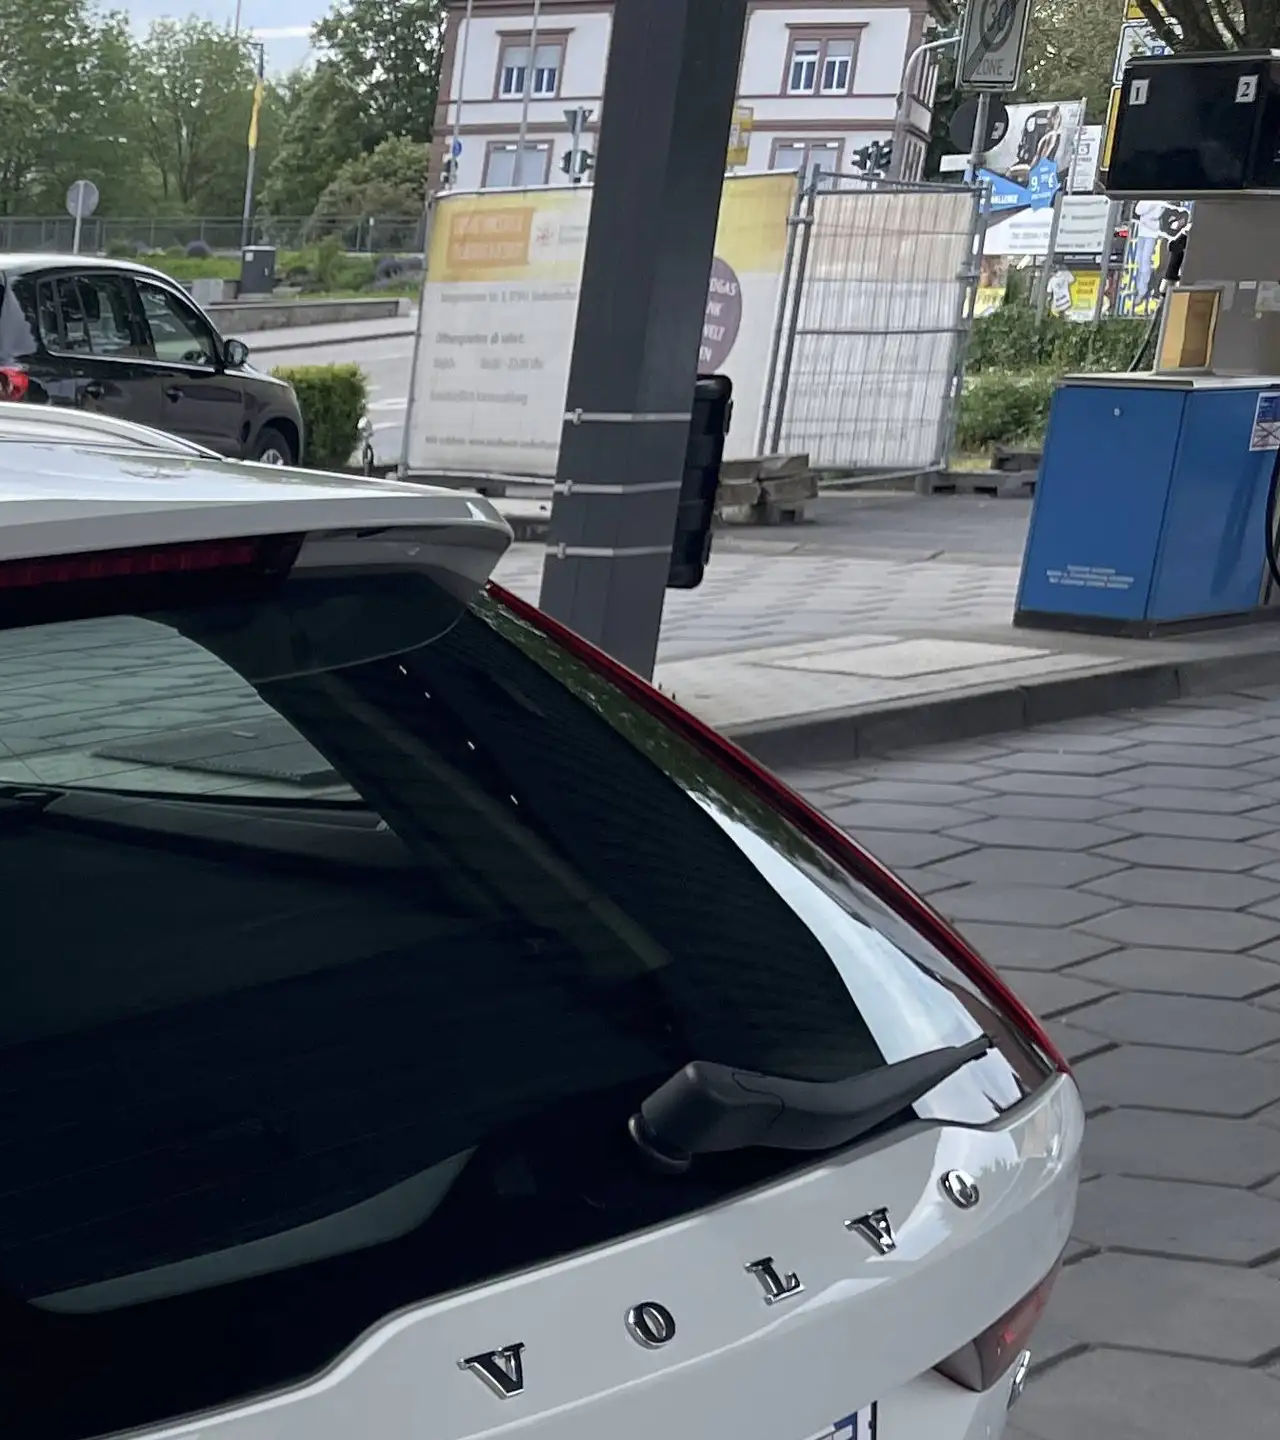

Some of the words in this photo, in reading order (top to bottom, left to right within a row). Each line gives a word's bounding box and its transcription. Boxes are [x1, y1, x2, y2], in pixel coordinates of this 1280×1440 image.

[976, 59, 1005, 76] ZONE
[1240, 81, 1250, 97] 2
[456, 1168, 981, 1399] VOLVO
